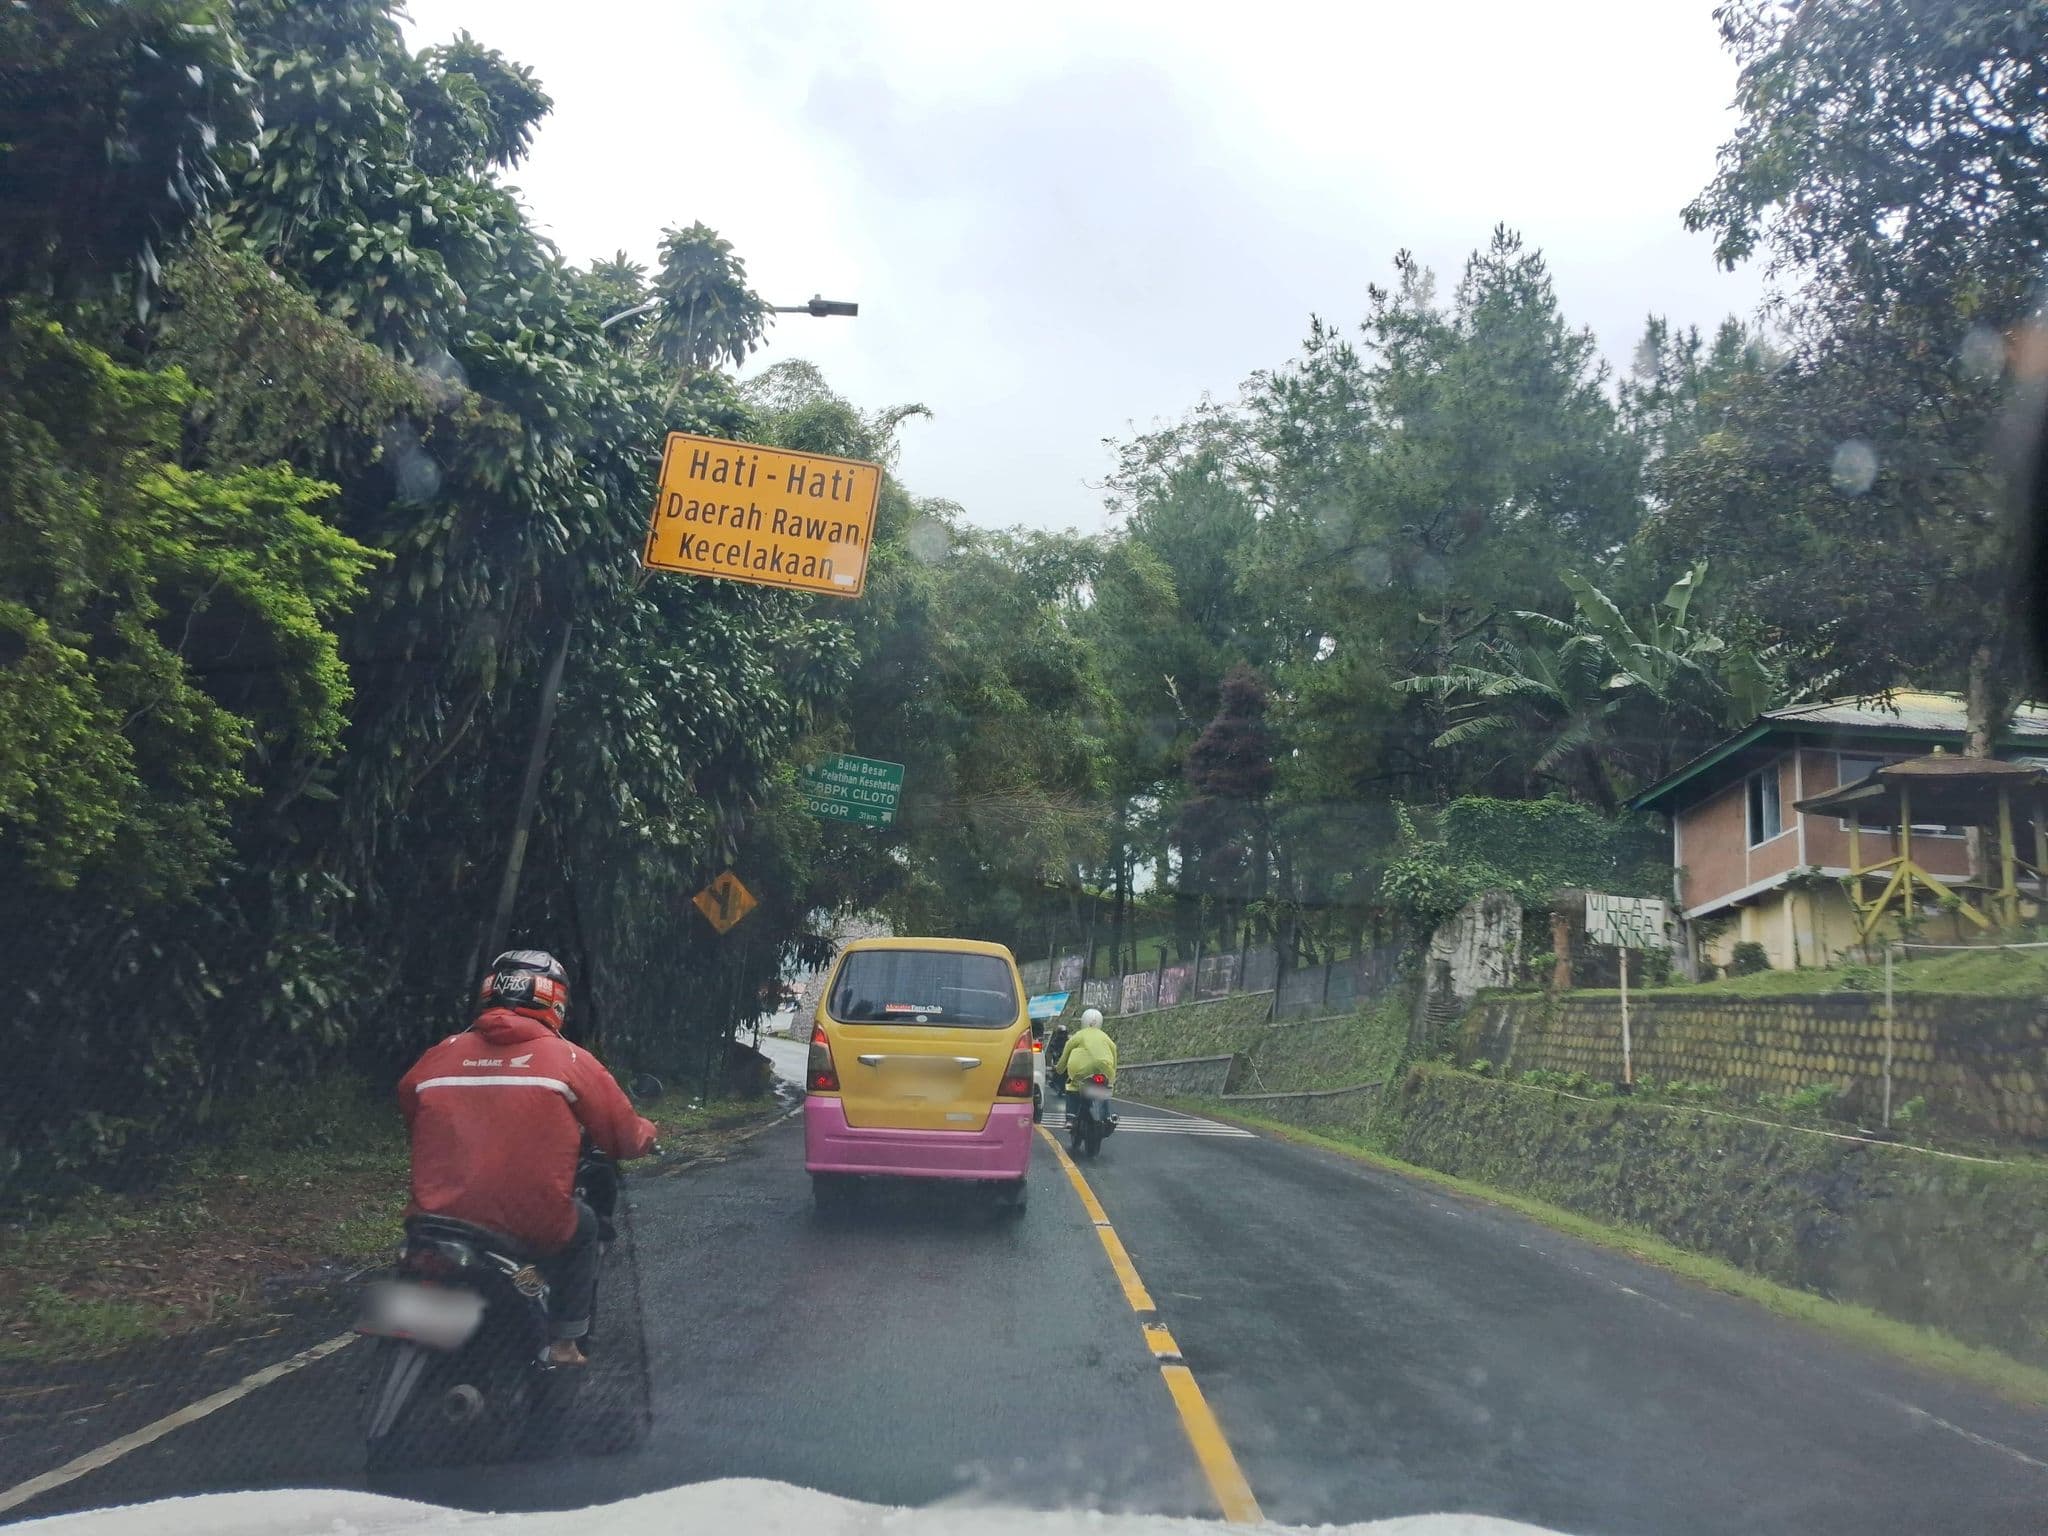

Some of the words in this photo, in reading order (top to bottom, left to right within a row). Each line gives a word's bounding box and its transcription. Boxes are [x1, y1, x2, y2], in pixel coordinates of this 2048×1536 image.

[689, 449, 759, 488] Hati
[786, 463, 855, 502] Hati
[666, 492, 762, 531] Daerah
[771, 508, 860, 546] Rawan
[678, 532, 834, 580] Kecelakaan
[821, 769, 858, 785] Pelatihan
[859, 776, 900, 792] Kesehatan
[838, 759, 859, 772] Balai
[862, 763, 888, 777] Besar
[853, 789, 895, 805] CILOTO
